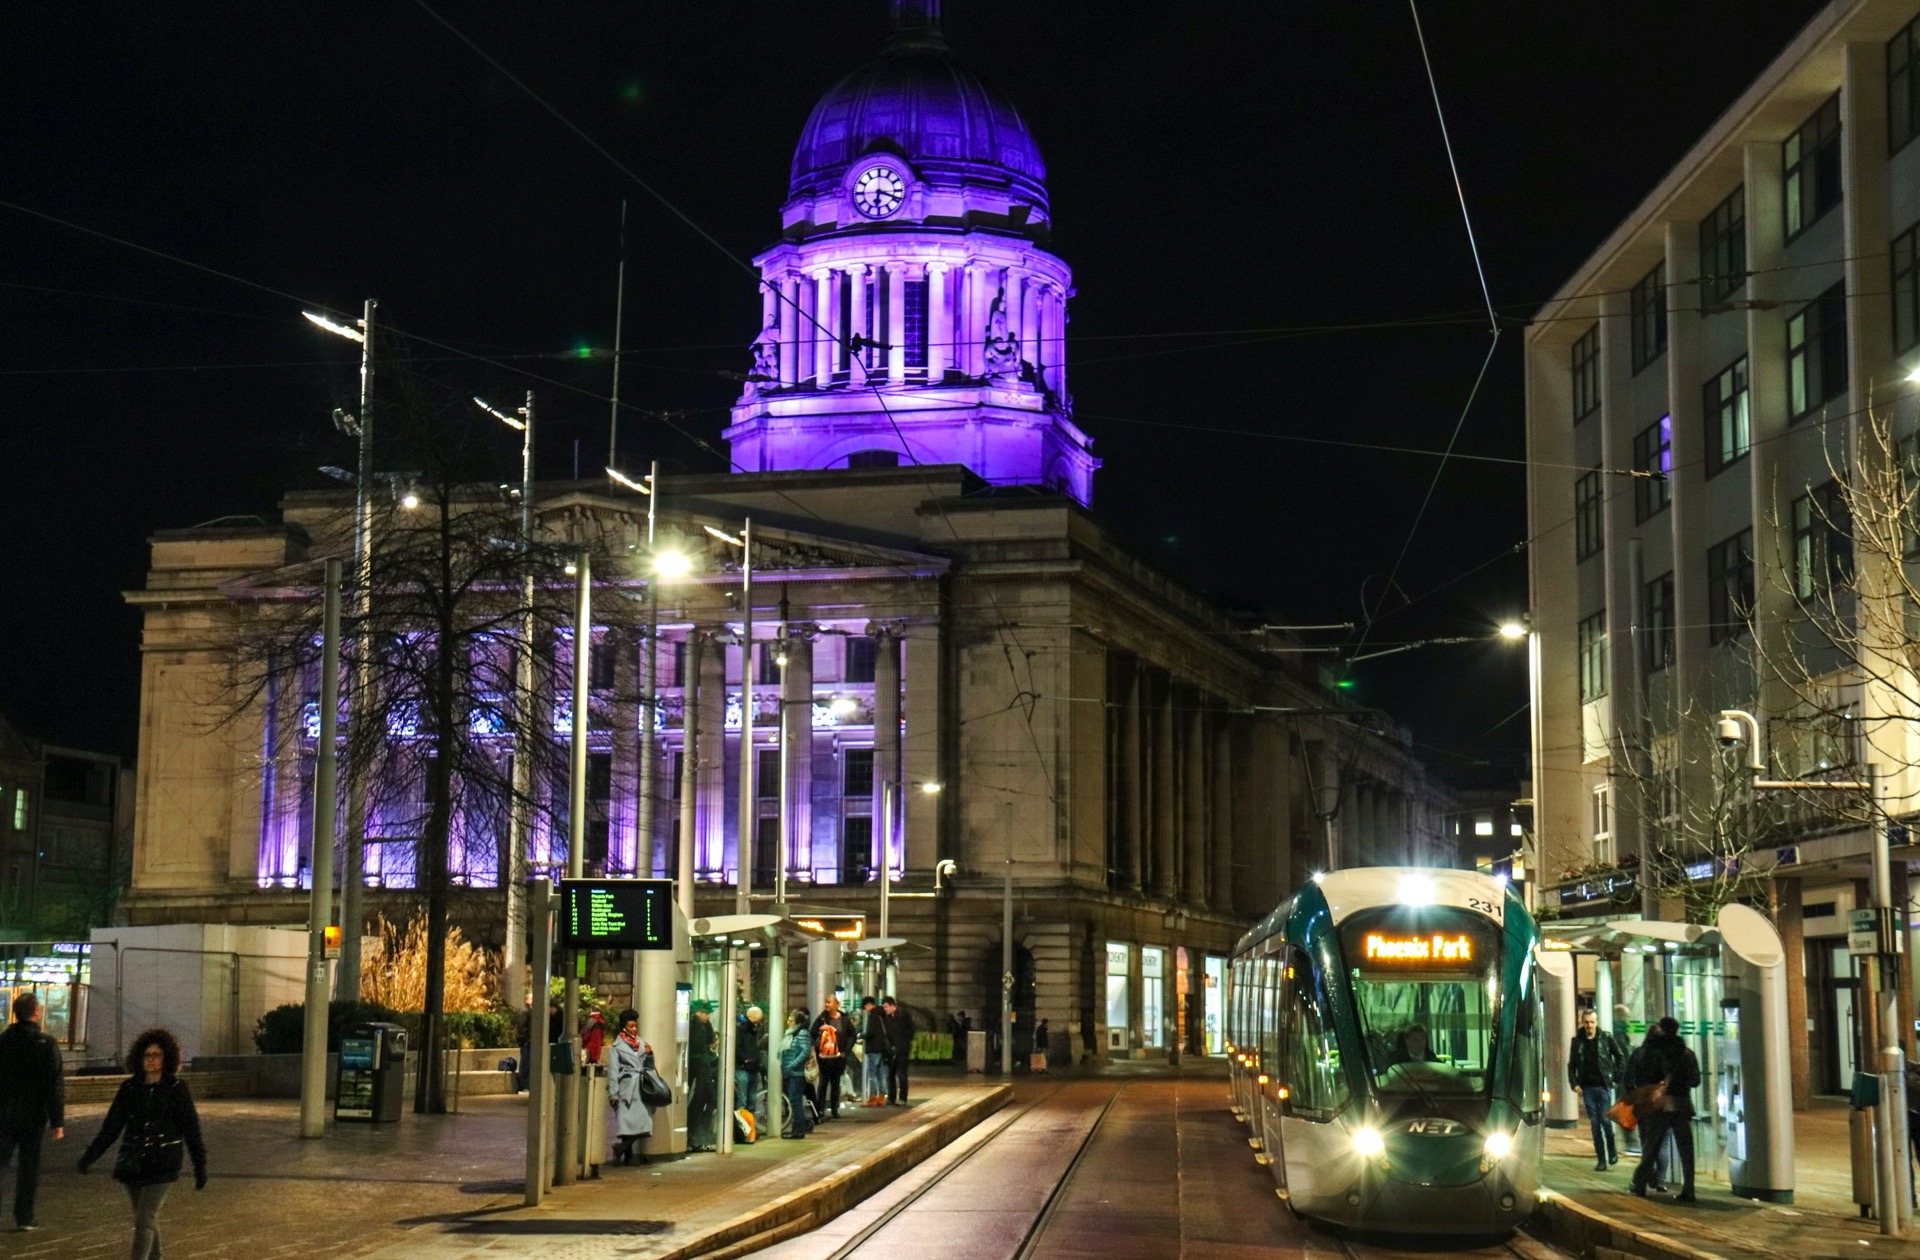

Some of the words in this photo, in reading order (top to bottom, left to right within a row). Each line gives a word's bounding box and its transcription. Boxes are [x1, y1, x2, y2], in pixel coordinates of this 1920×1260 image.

[1469, 898, 1502, 917] 231
[1367, 935, 1429, 958] Phoenix
[1433, 935, 1471, 958] Park
[1003, 975, 1013, 984] 25
[1408, 1121, 1458, 1134] NET
